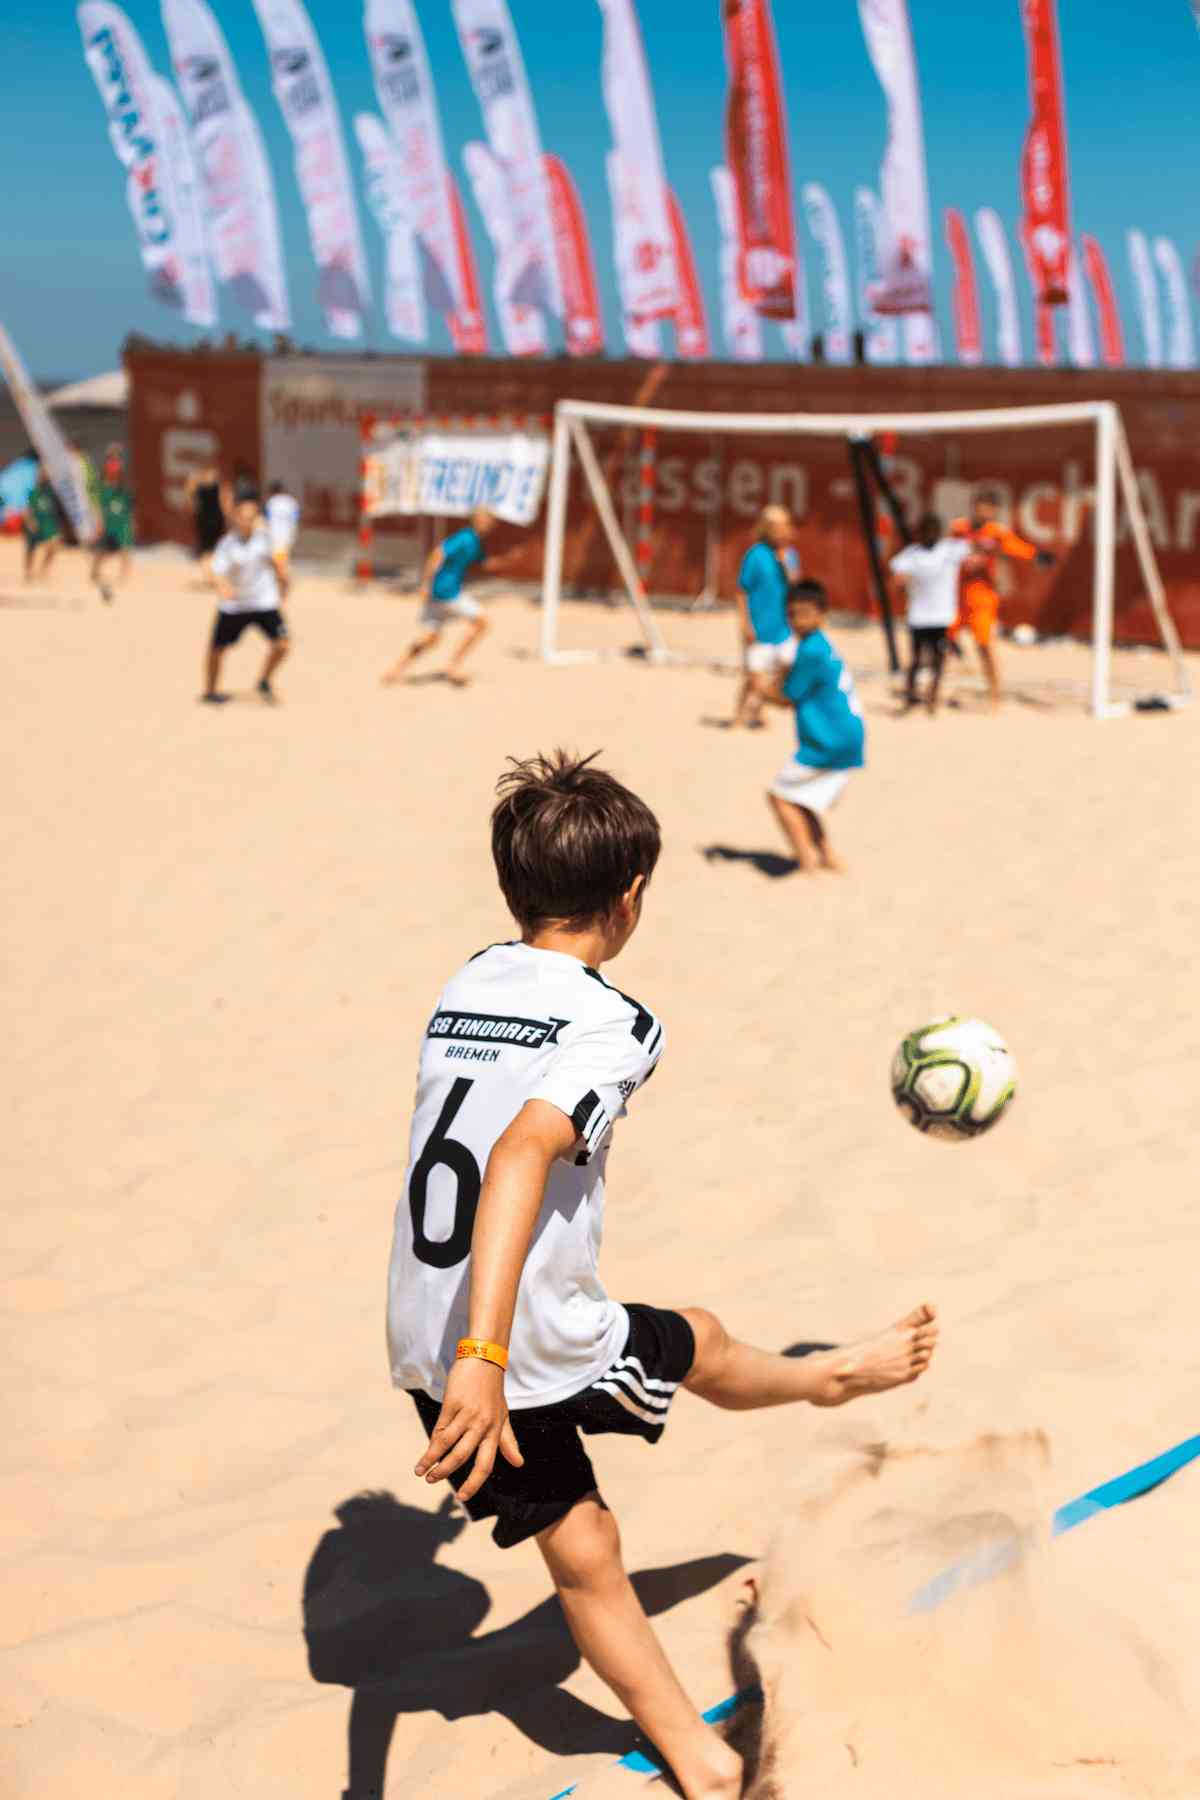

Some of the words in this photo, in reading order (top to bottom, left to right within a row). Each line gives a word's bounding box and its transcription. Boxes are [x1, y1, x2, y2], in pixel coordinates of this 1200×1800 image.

[430, 1016, 452, 1035] SG
[451, 1018, 548, 1043] FINDORFF
[444, 1046, 501, 1062] BREMEN
[409, 1077, 481, 1269] 6
